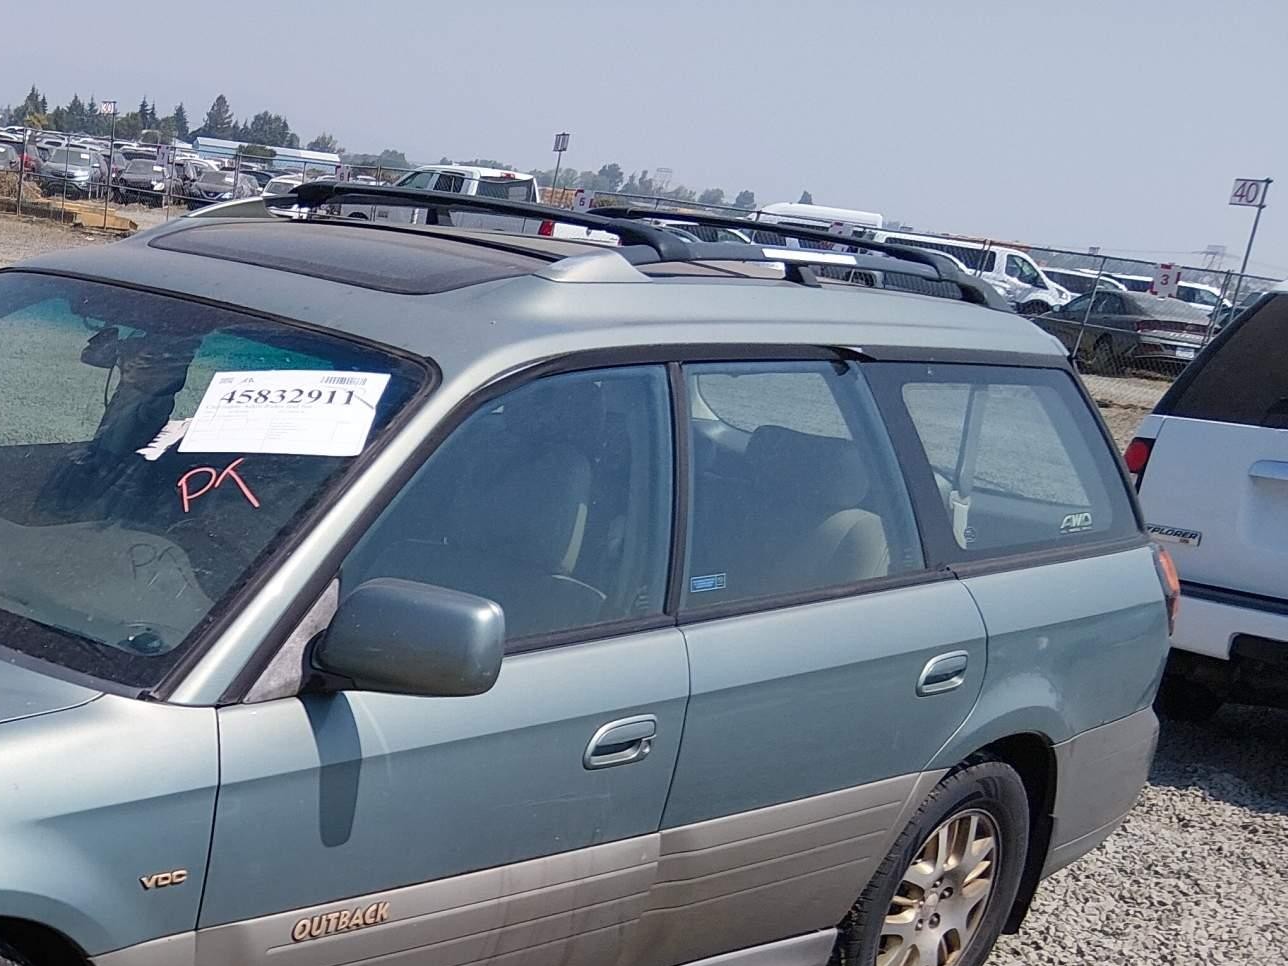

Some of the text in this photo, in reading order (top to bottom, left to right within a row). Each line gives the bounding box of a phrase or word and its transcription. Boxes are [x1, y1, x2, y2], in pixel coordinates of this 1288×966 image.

[1232, 181, 1260, 204] 40
[1160, 274, 1170, 286] 3
[220, 388, 355, 405] 45832911
[1060, 512, 1092, 529] AWD
[139, 869, 188, 890] VDC
[291, 901, 390, 943] OUTBACK
